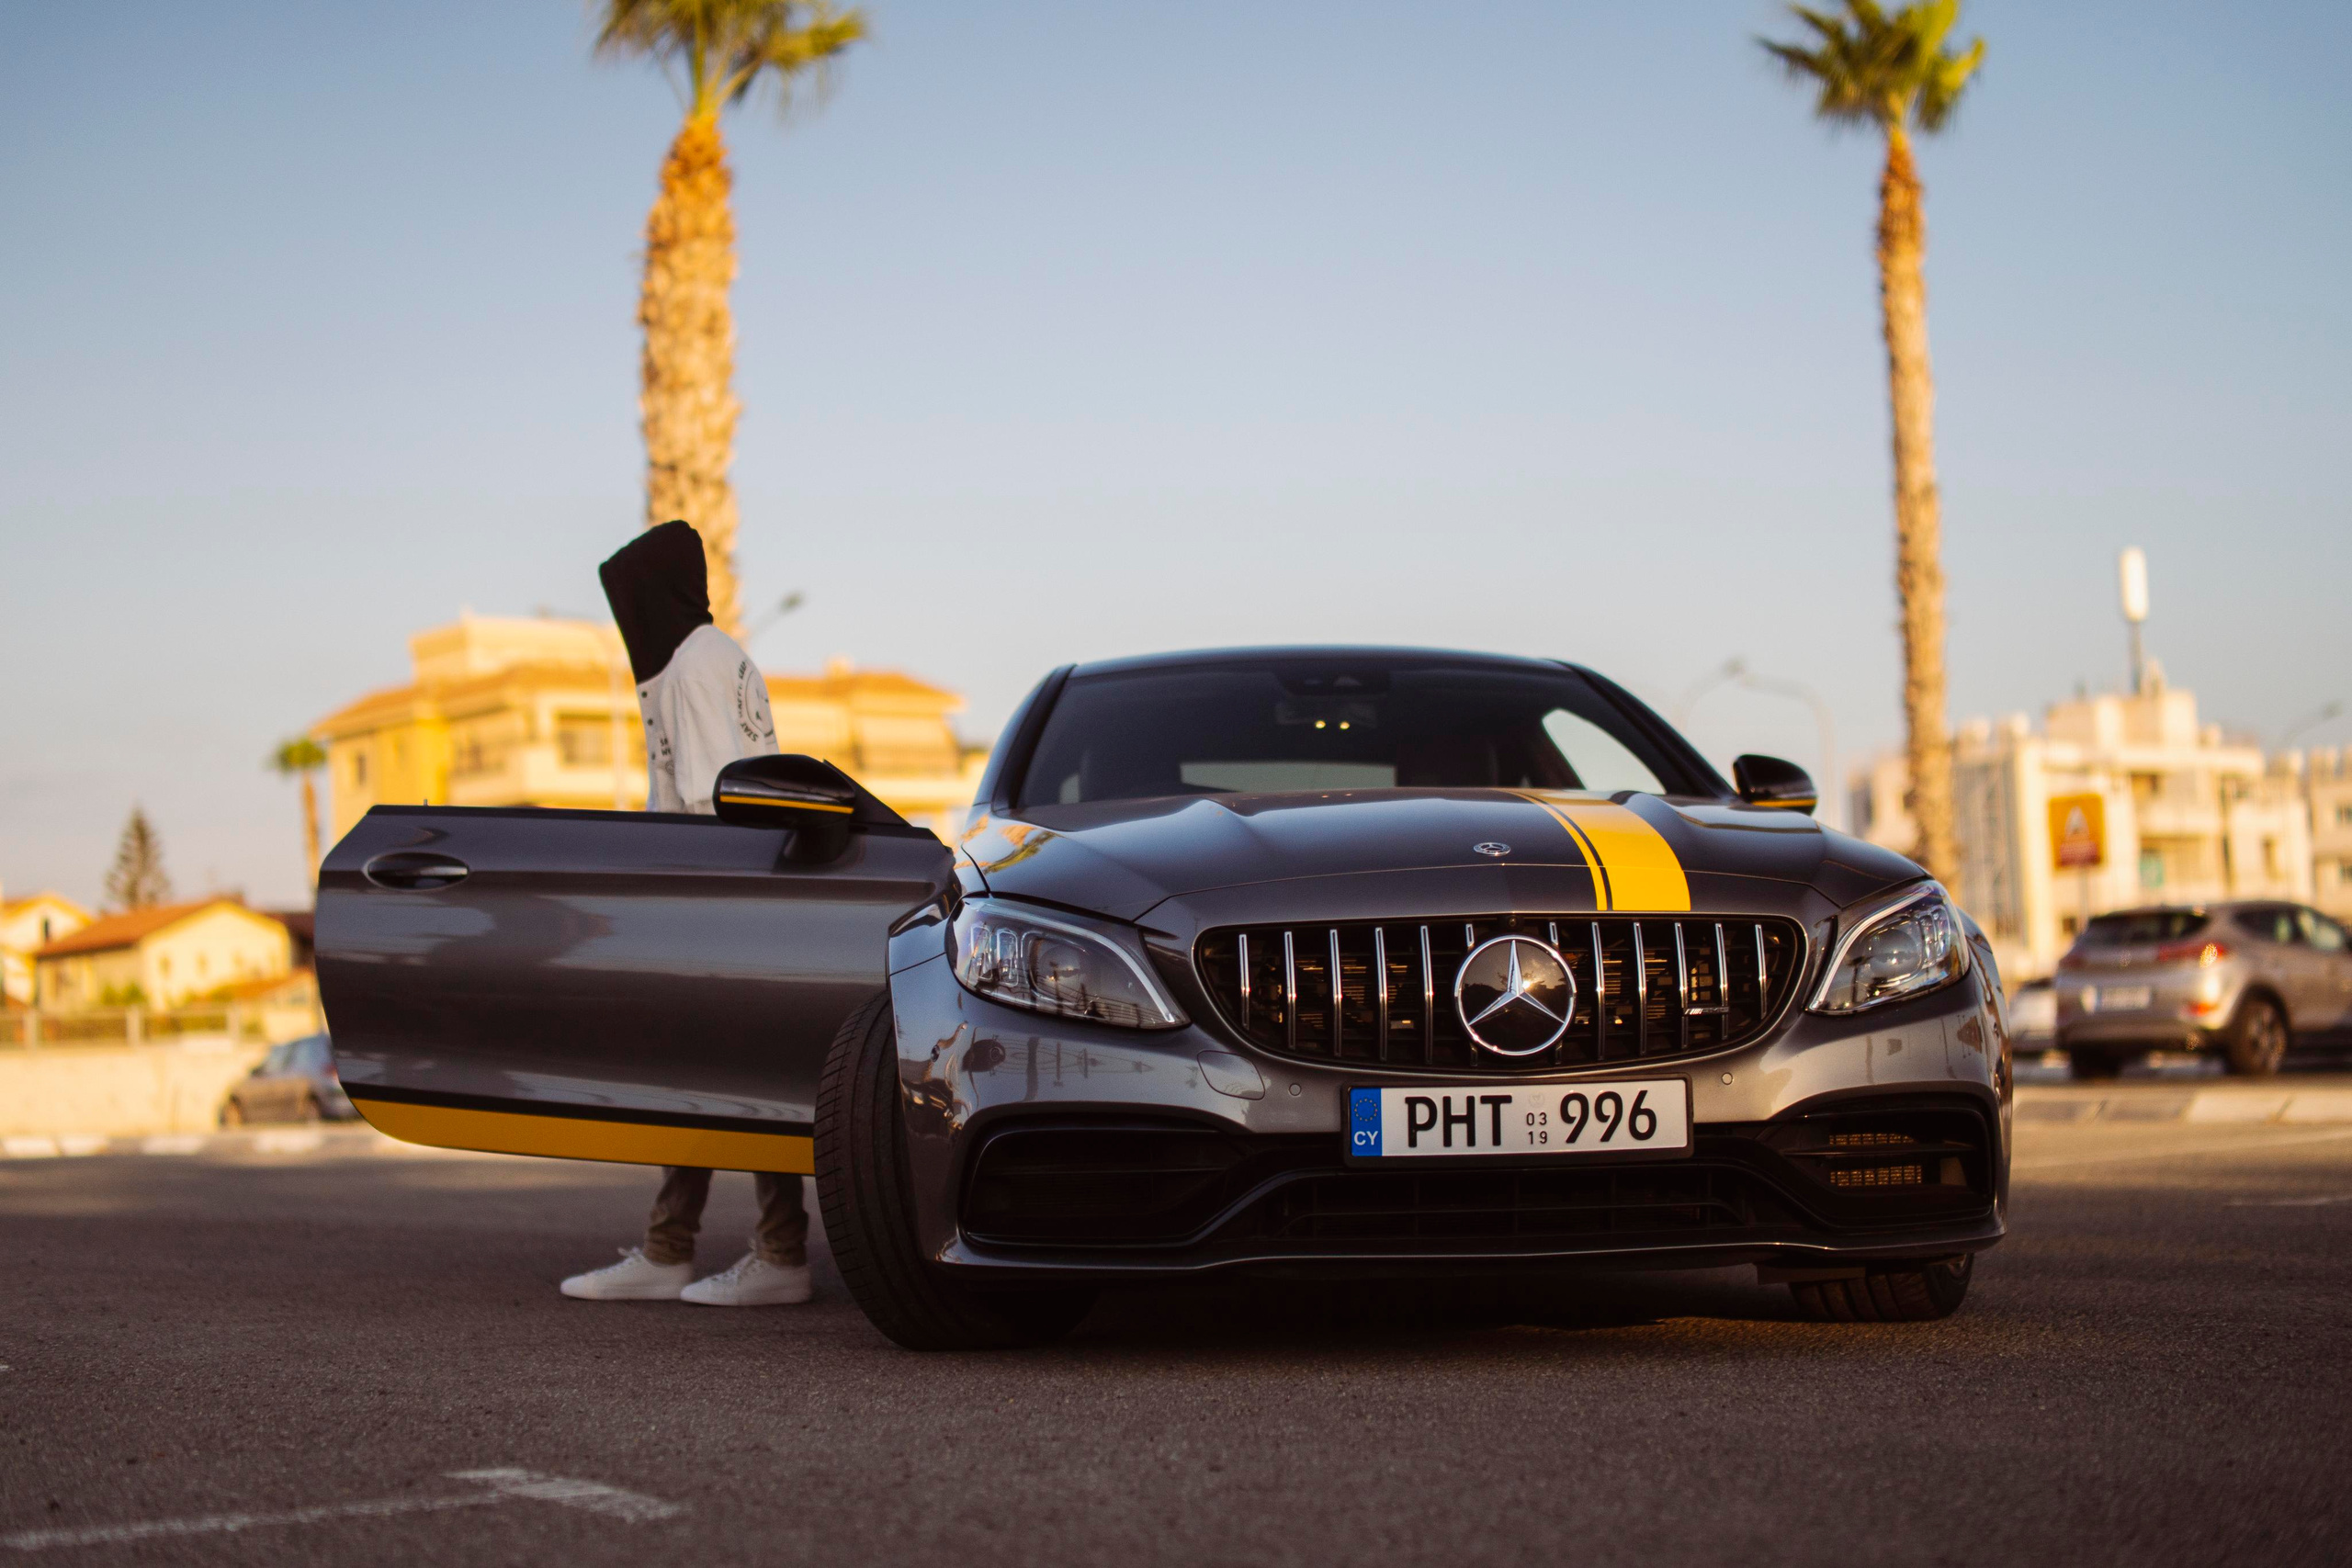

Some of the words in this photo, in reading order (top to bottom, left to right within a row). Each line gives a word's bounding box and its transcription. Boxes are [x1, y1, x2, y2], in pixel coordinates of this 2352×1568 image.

[1405, 1095, 1512, 1148] PHT
[1560, 1089, 1657, 1144] 996
[1526, 1111, 1547, 1126] 03
[1353, 1131, 1378, 1146] CY
[1528, 1130, 1548, 1145] 19
